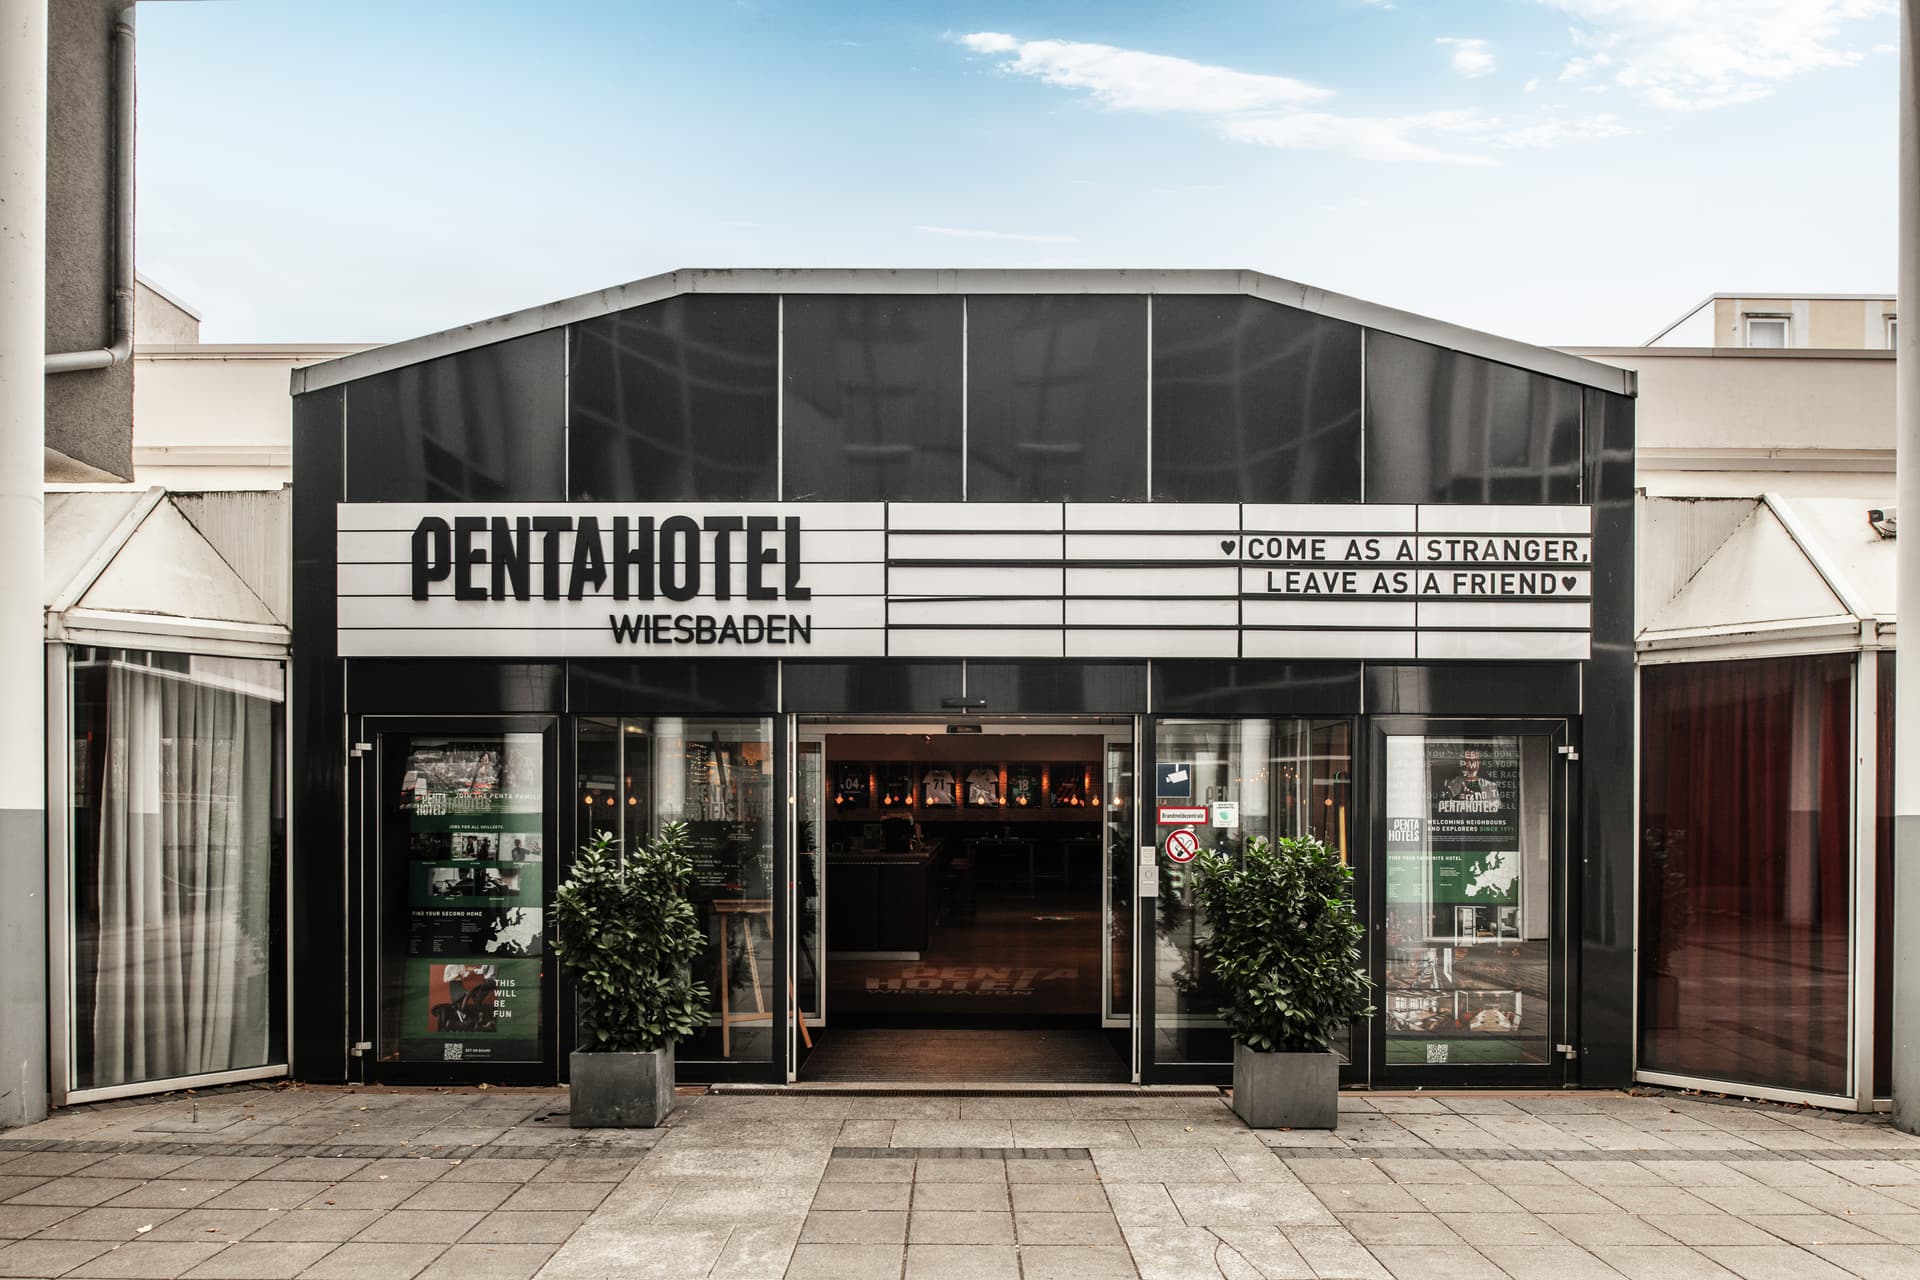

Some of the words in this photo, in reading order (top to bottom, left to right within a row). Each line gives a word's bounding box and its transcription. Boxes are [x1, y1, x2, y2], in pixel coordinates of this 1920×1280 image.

[1248, 538, 1326, 560] COME
[1345, 539, 1381, 561] AS
[1396, 539, 1414, 561] A
[1427, 539, 1589, 562] STRANGER,
[411, 515, 811, 601] PENTAHOTEL
[1267, 571, 1357, 593] LEAVE
[1372, 572, 1408, 593] AS
[1423, 572, 1441, 594] A
[1453, 573, 1557, 594] FRIEND
[609, 614, 811, 645] WIESBADEN
[1393, 819, 1420, 831] PENTA
[1388, 830, 1420, 842] HOTELS
[494, 979, 516, 987] THIS
[493, 989, 517, 998] WILL
[493, 999, 506, 1008] BE
[493, 1010, 512, 1018] FUN
